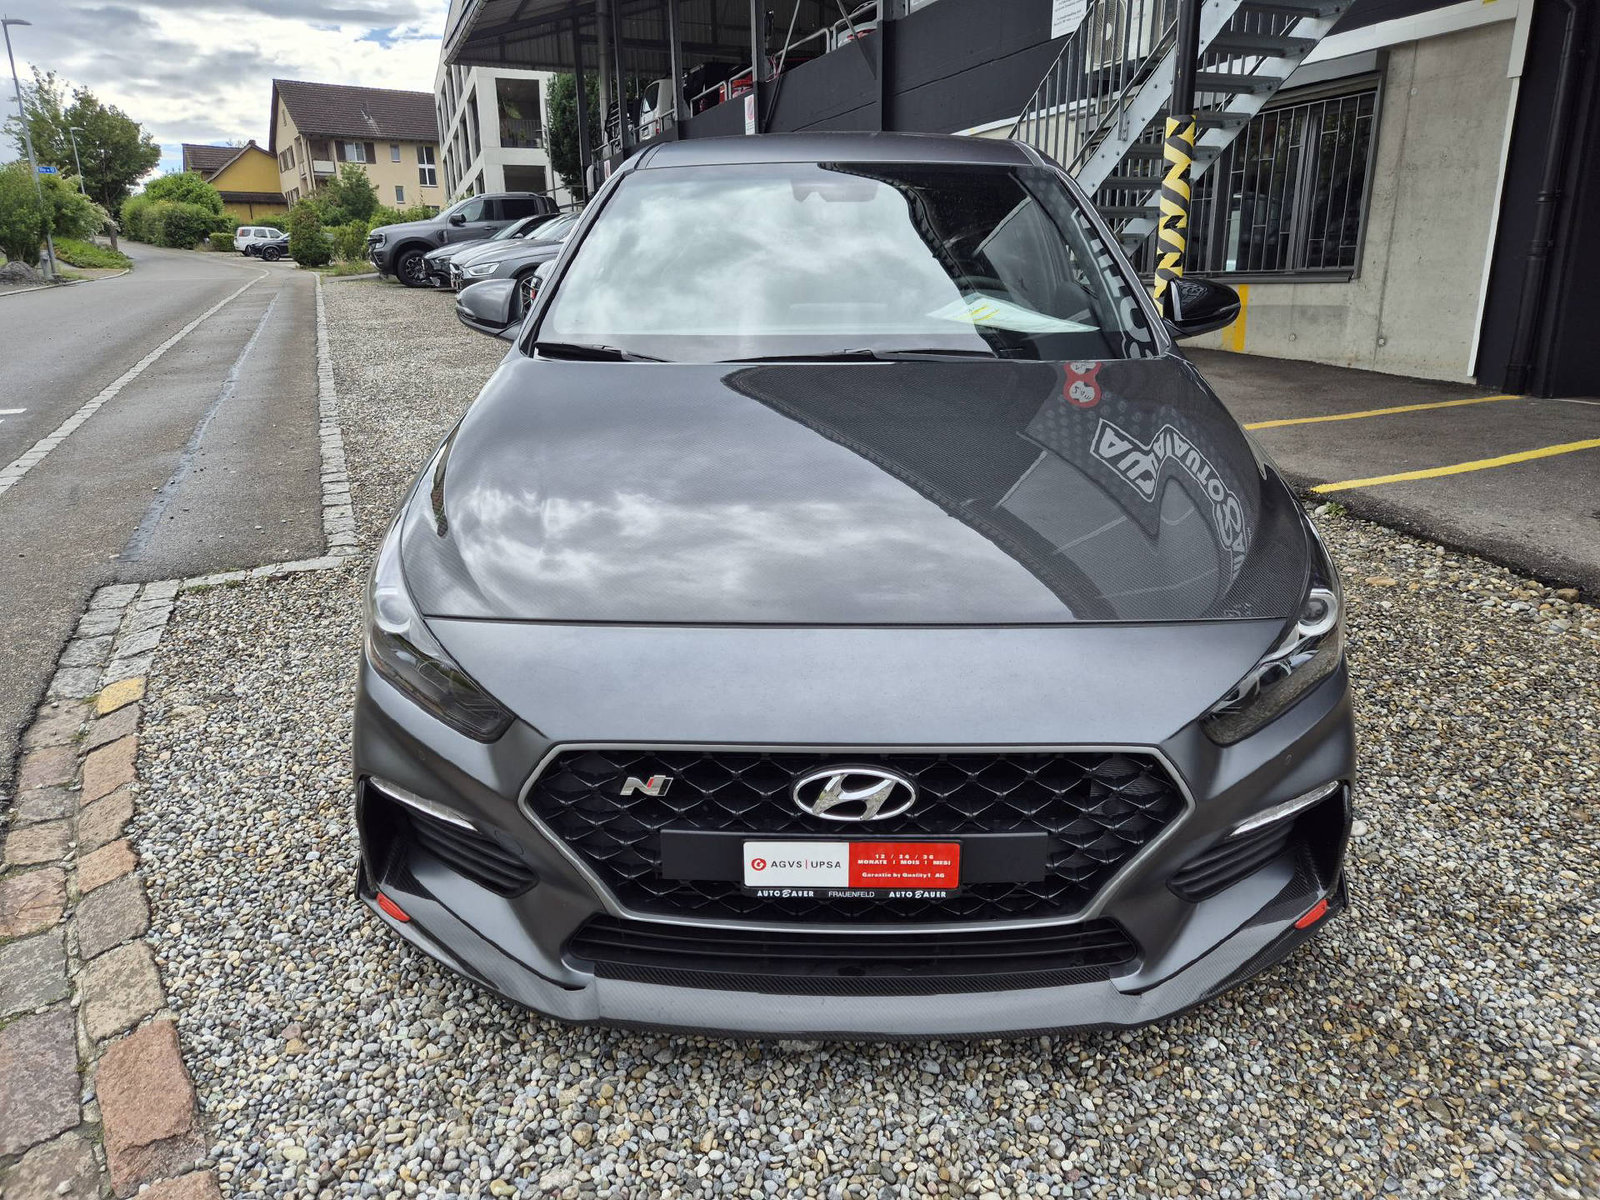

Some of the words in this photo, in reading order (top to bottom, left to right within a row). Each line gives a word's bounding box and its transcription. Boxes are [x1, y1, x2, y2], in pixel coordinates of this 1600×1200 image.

[770, 860, 802, 869] AGVS
[810, 860, 841, 869] UPSA
[781, 889, 814, 898] BAUER
[914, 889, 946, 899] BAUER
